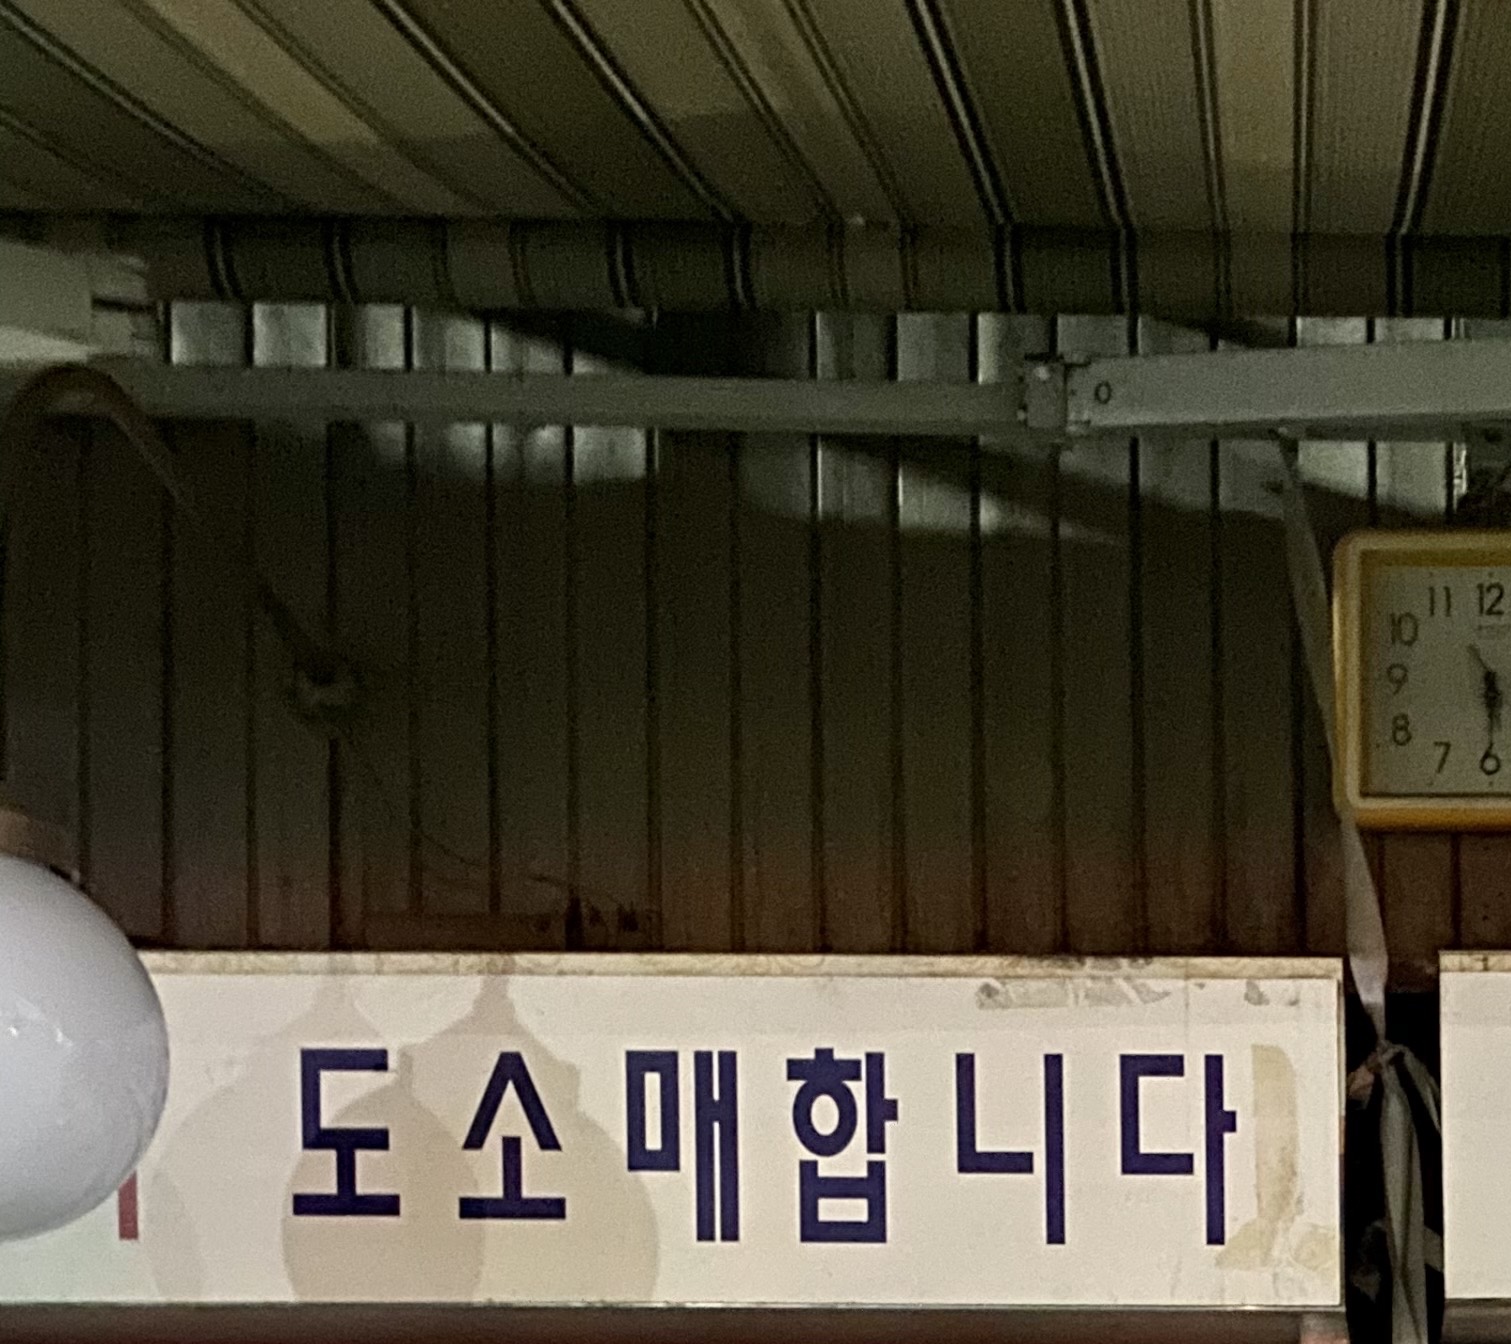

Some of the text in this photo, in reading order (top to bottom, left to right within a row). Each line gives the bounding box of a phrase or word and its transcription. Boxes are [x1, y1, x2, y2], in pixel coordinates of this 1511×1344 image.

[1429, 586, 1451, 617] 11
[1477, 582, 1505, 616] 12
[1389, 611, 1419, 647] 10
[1387, 663, 1409, 695] 9
[1390, 713, 1412, 746] 8
[1433, 741, 1451, 773] 7
[1479, 744, 1501, 775] 6
